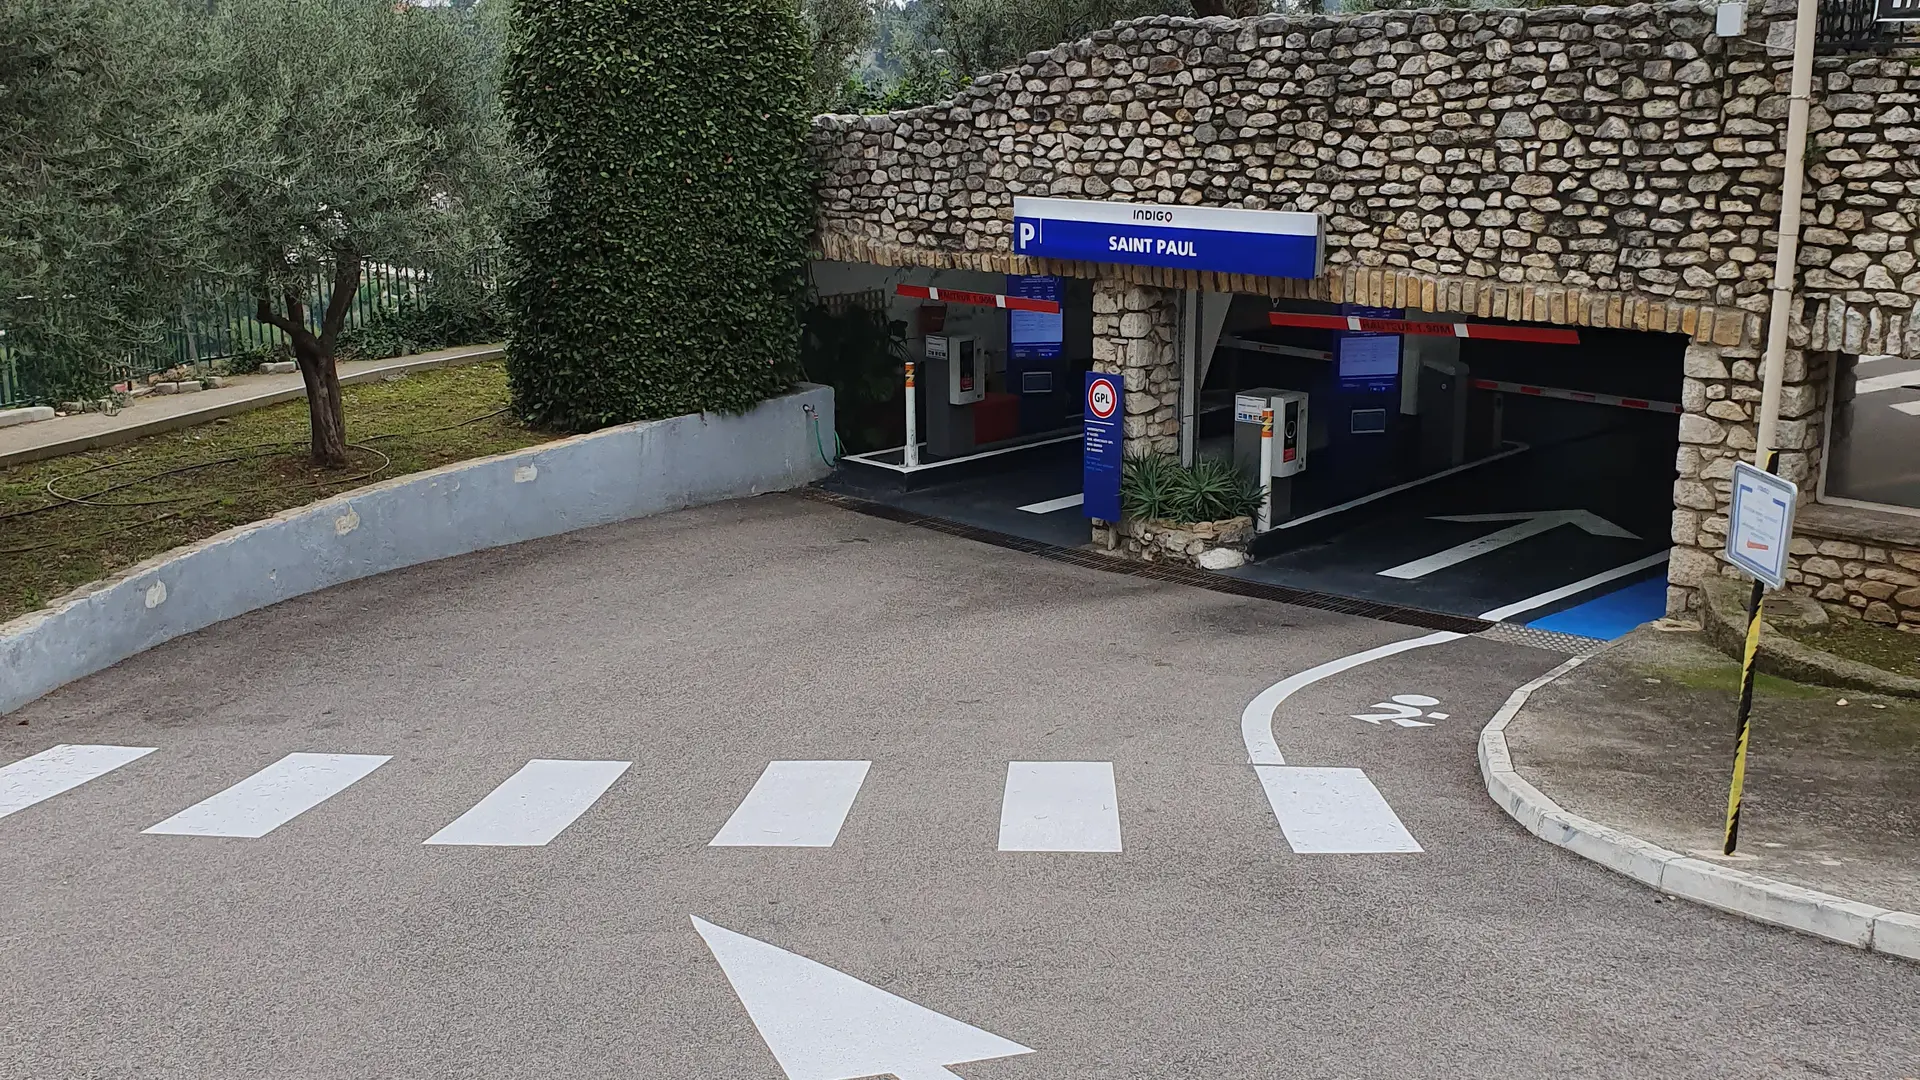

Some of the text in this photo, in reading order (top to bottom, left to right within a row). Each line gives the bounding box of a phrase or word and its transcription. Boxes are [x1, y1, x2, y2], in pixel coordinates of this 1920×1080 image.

[1133, 209, 1173, 223] INDIGO
[1020, 223, 1035, 249] P
[1108, 236, 1197, 257] SAINT PAUL
[1362, 320, 1412, 332] HAUTEUR
[1094, 392, 1110, 405] GPL
